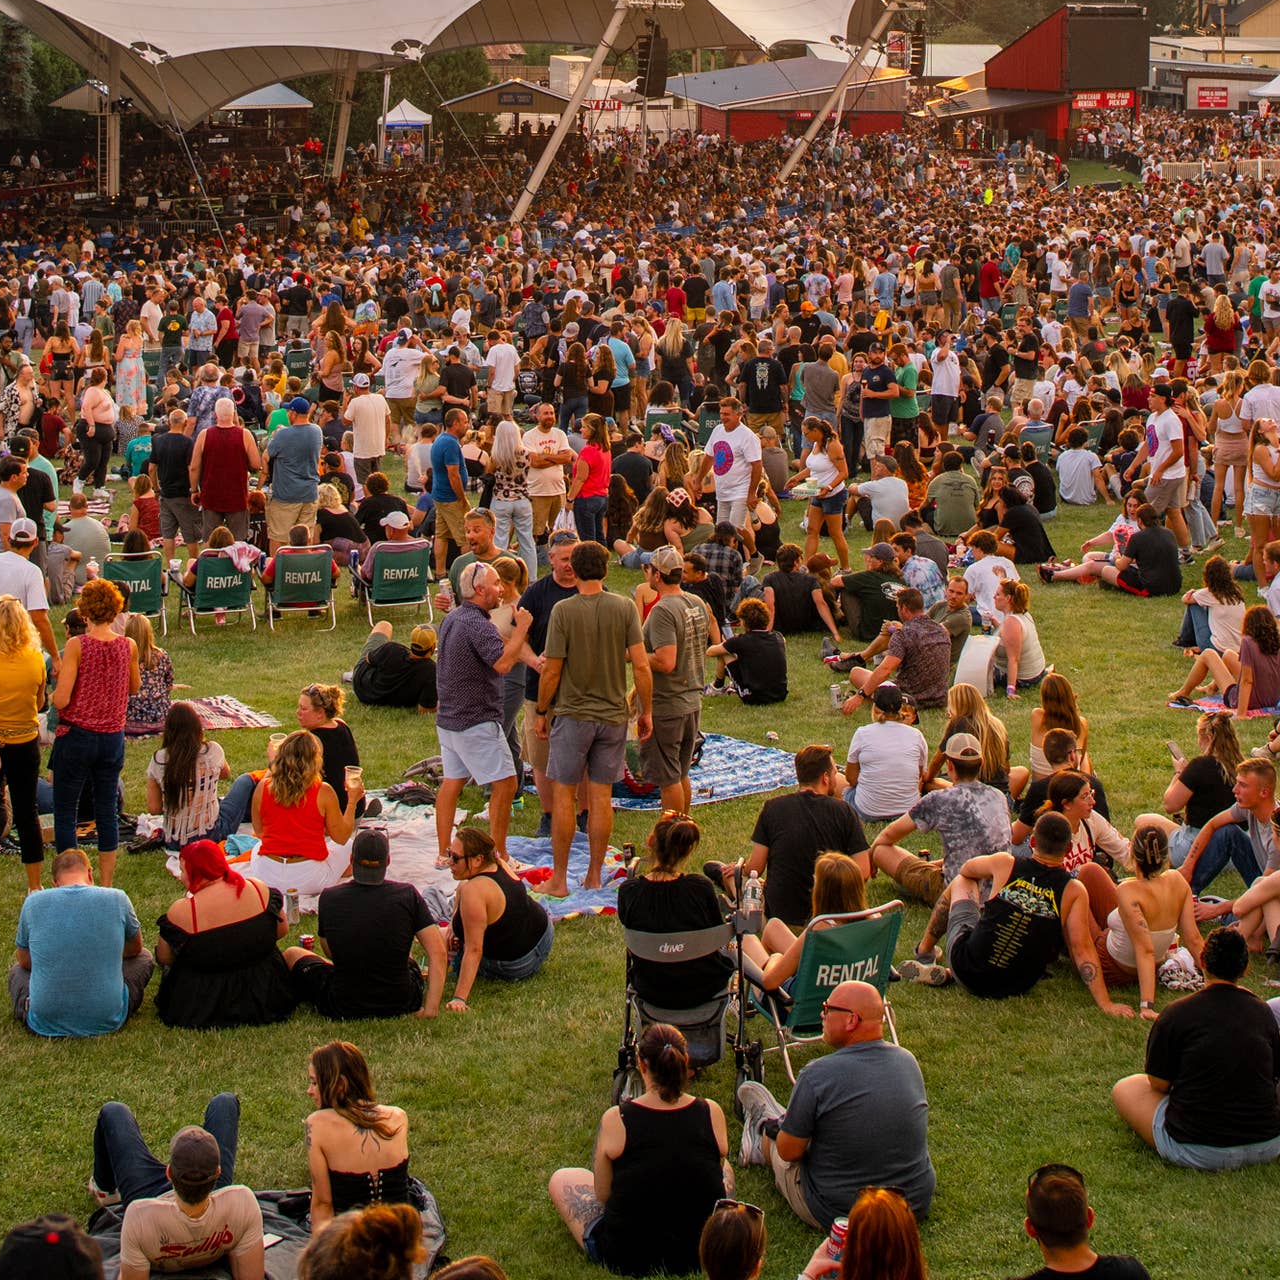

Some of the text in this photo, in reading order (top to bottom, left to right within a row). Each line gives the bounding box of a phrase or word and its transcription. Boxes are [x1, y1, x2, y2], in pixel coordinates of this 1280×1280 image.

[599, 101, 619, 109] EXIT
[285, 571, 322, 584] RENTAL
[383, 567, 419, 580] RENTAL
[206, 574, 243, 589] RENTAL
[658, 942, 684, 953] drive
[816, 954, 879, 986] RENTAL
